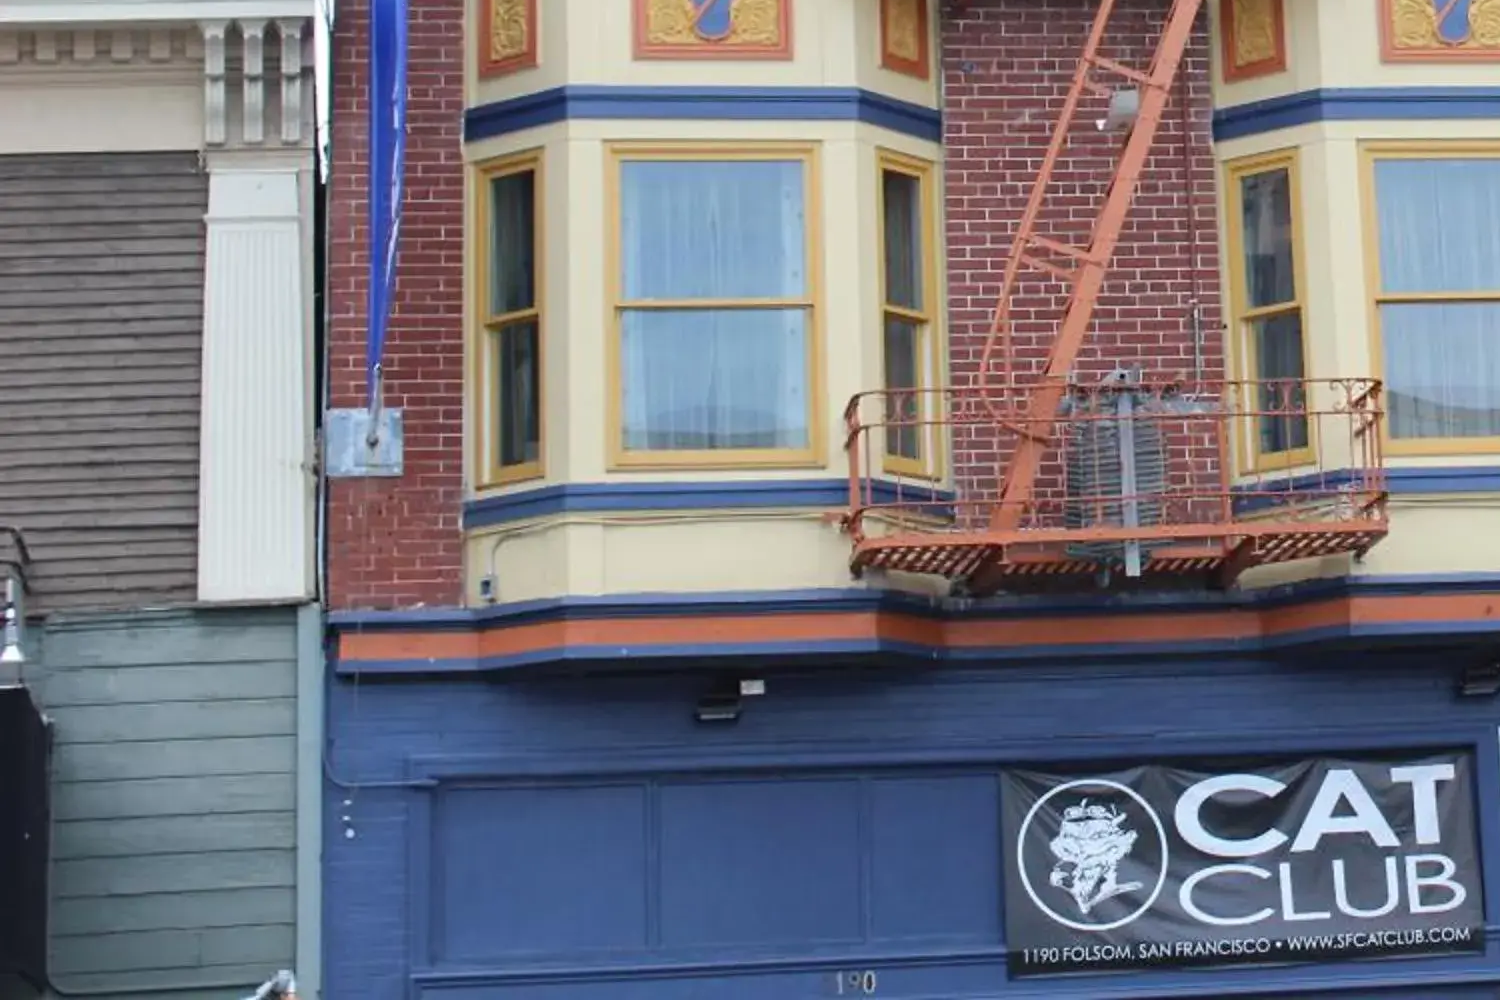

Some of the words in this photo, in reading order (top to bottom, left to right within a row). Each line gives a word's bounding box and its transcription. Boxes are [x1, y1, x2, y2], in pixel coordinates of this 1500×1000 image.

[1174, 763, 1455, 857] CAT
[1179, 853, 1467, 926] CLUB
[1023, 948, 1059, 964] 1190
[1139, 943, 1172, 959] SAN
[1175, 938, 1271, 957] FRANCISCO
[1287, 927, 1471, 951] WWW.SFCATCLUB.COM
